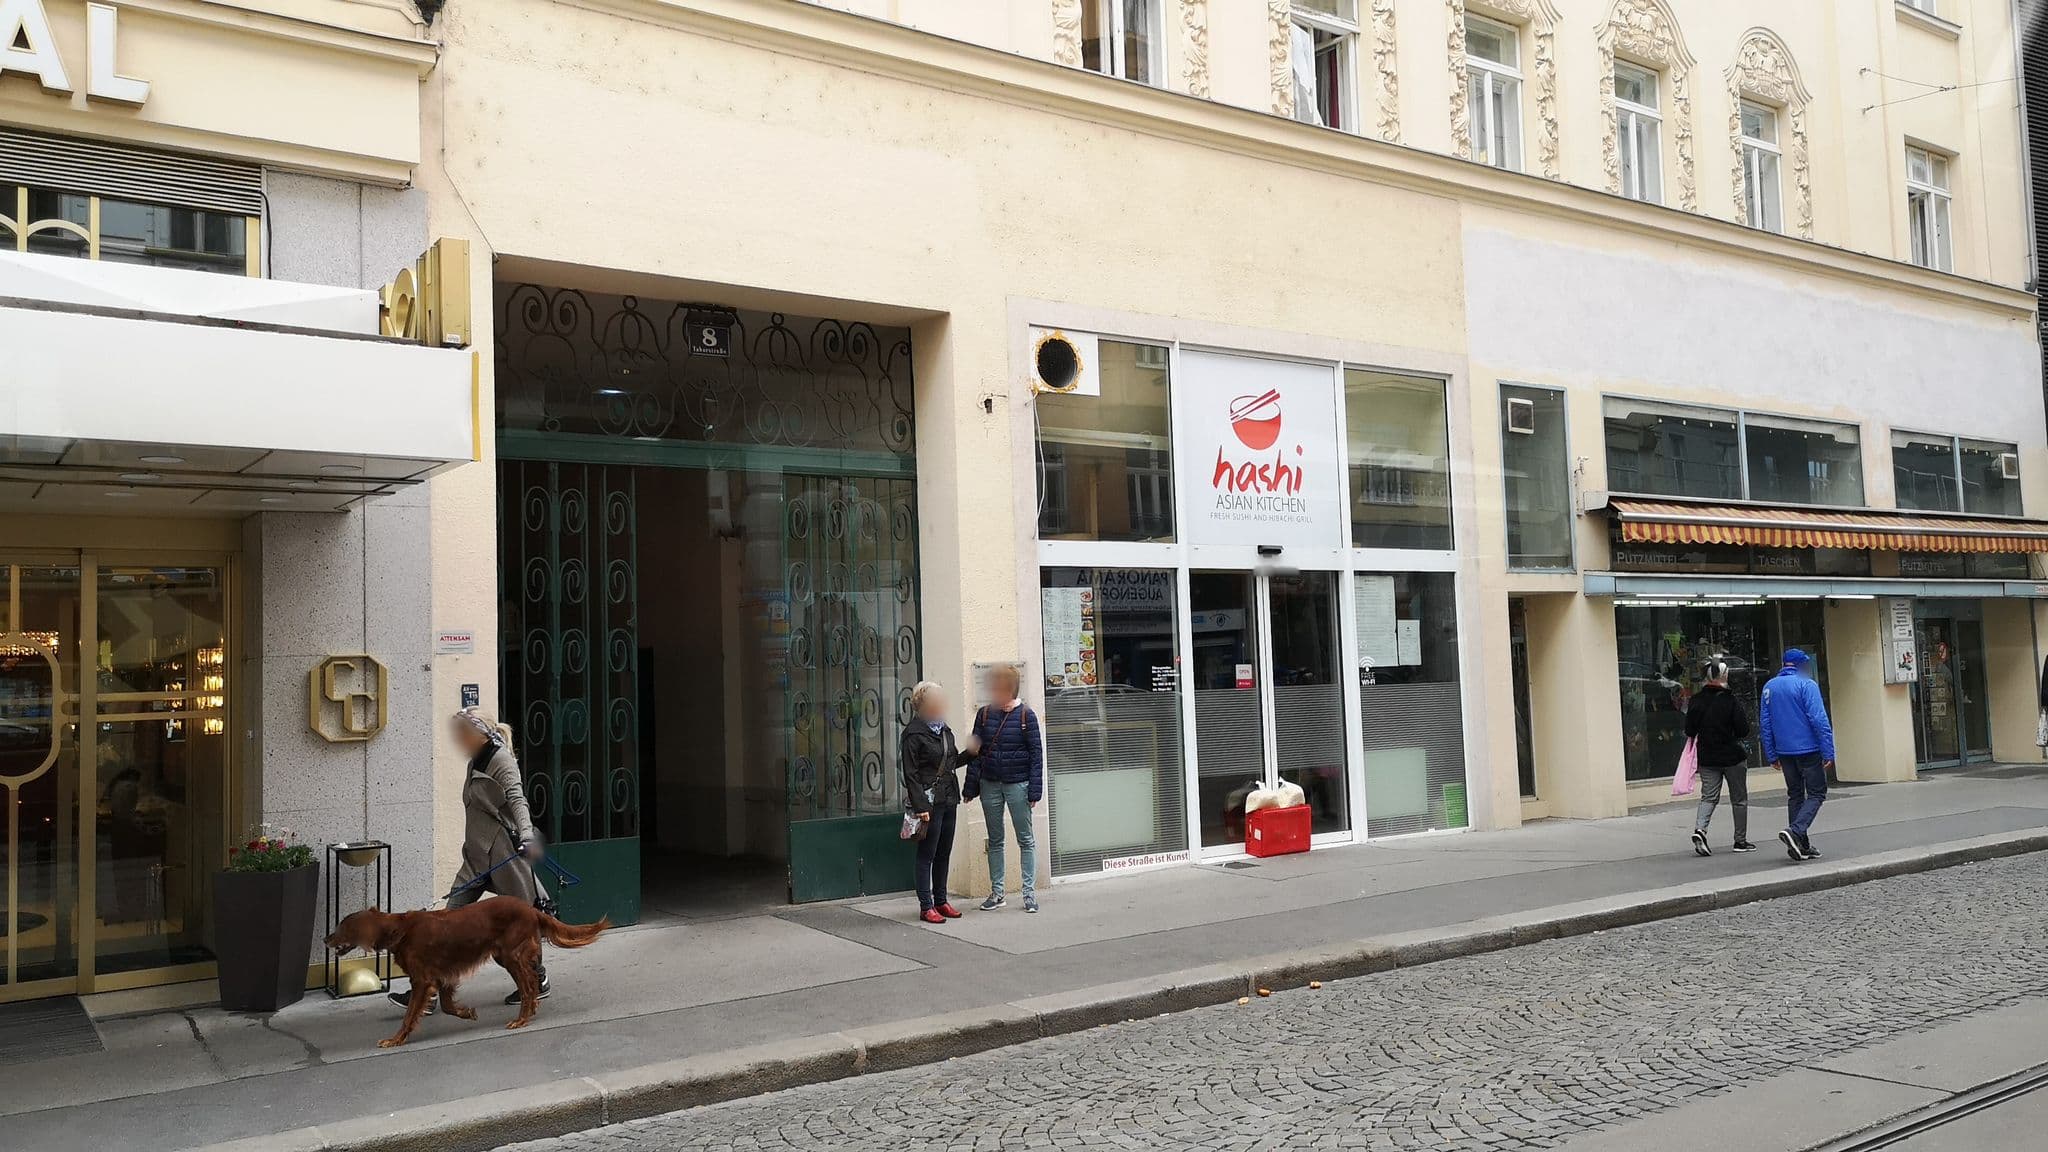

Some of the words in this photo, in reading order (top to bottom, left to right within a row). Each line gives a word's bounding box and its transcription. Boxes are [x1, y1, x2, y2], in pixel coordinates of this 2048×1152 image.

[702, 327, 718, 347] 8
[1212, 444, 1304, 497] hashi
[1216, 494, 1253, 510] ASIAN
[1256, 496, 1306, 513] KITCHEN
[1210, 512, 1231, 521] FRESH
[1232, 512, 1252, 521] SUSHI
[1253, 514, 1268, 522] AND
[1269, 514, 1295, 523] HIBACHI
[1296, 515, 1313, 524] GRILL
[1757, 554, 1801, 568] TASCHEN
[1361, 672, 1375, 680] FREE
[1104, 859, 1127, 870] Diese
[1128, 855, 1154, 868] Straße
[1155, 854, 1165, 864] ist
[1166, 851, 1189, 862] Kunst
